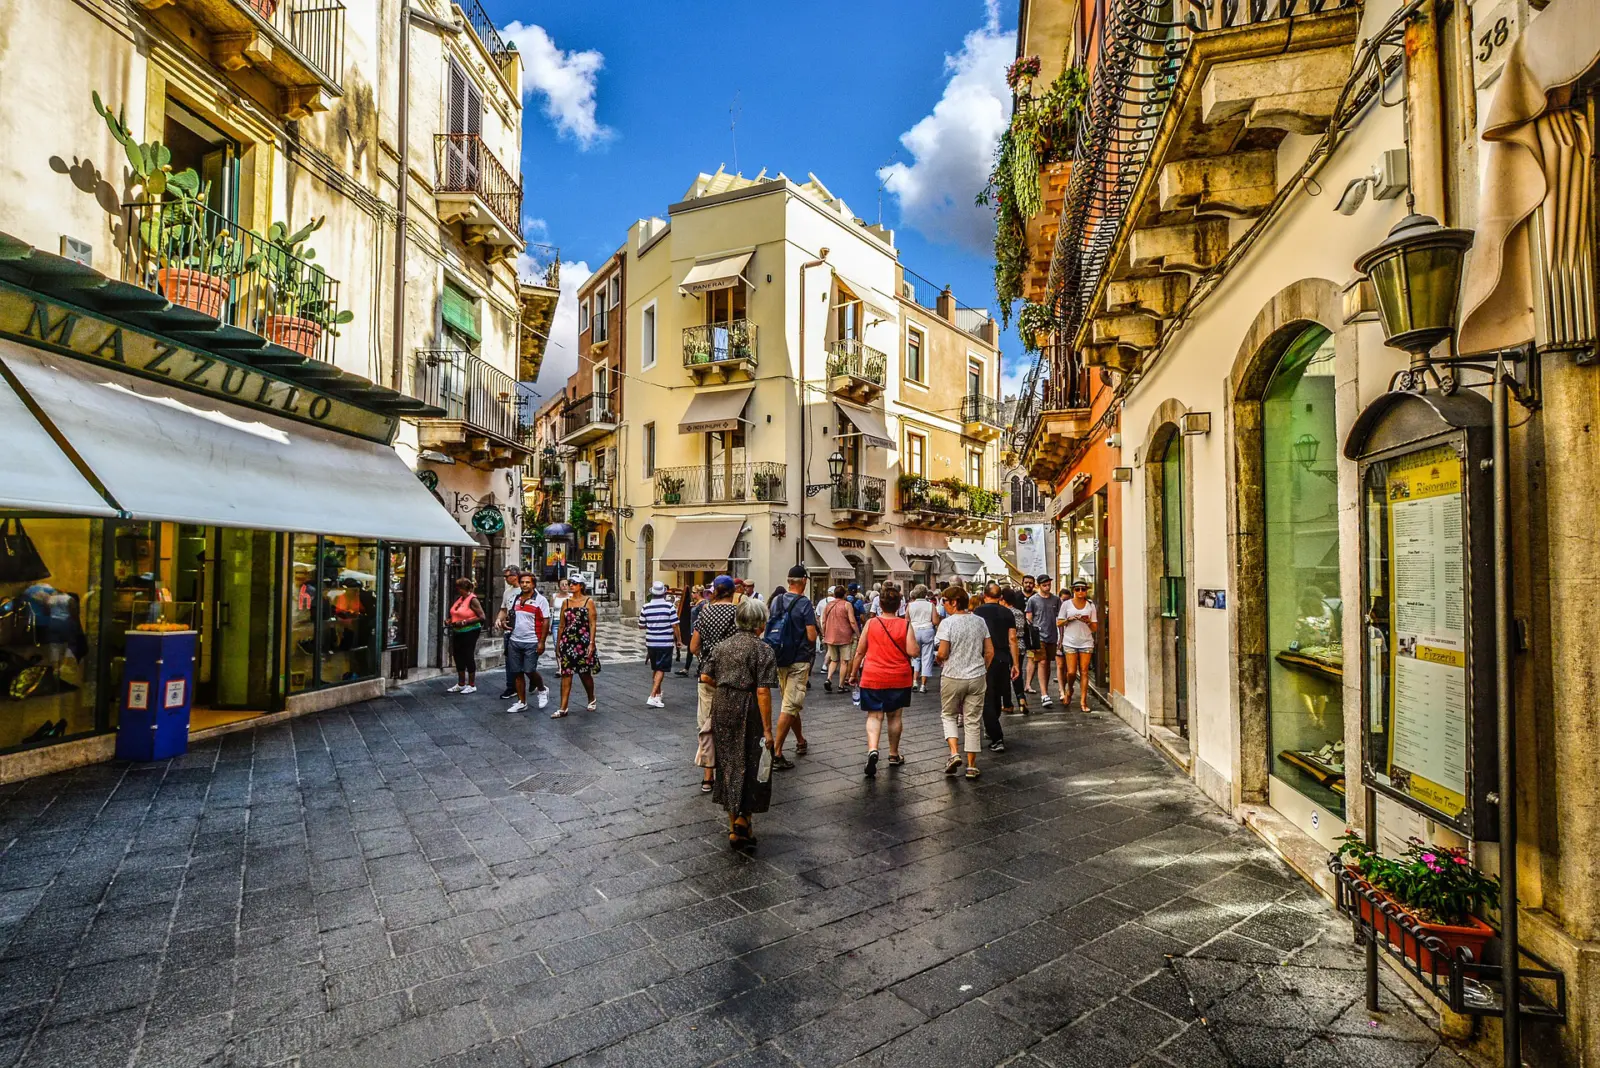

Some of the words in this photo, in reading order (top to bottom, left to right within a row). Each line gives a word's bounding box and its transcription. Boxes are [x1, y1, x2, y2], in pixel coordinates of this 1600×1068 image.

[20, 299, 332, 421] MAZZULLO
[581, 552, 603, 561] ARTE
[1424, 647, 1457, 664] Pizzeria
